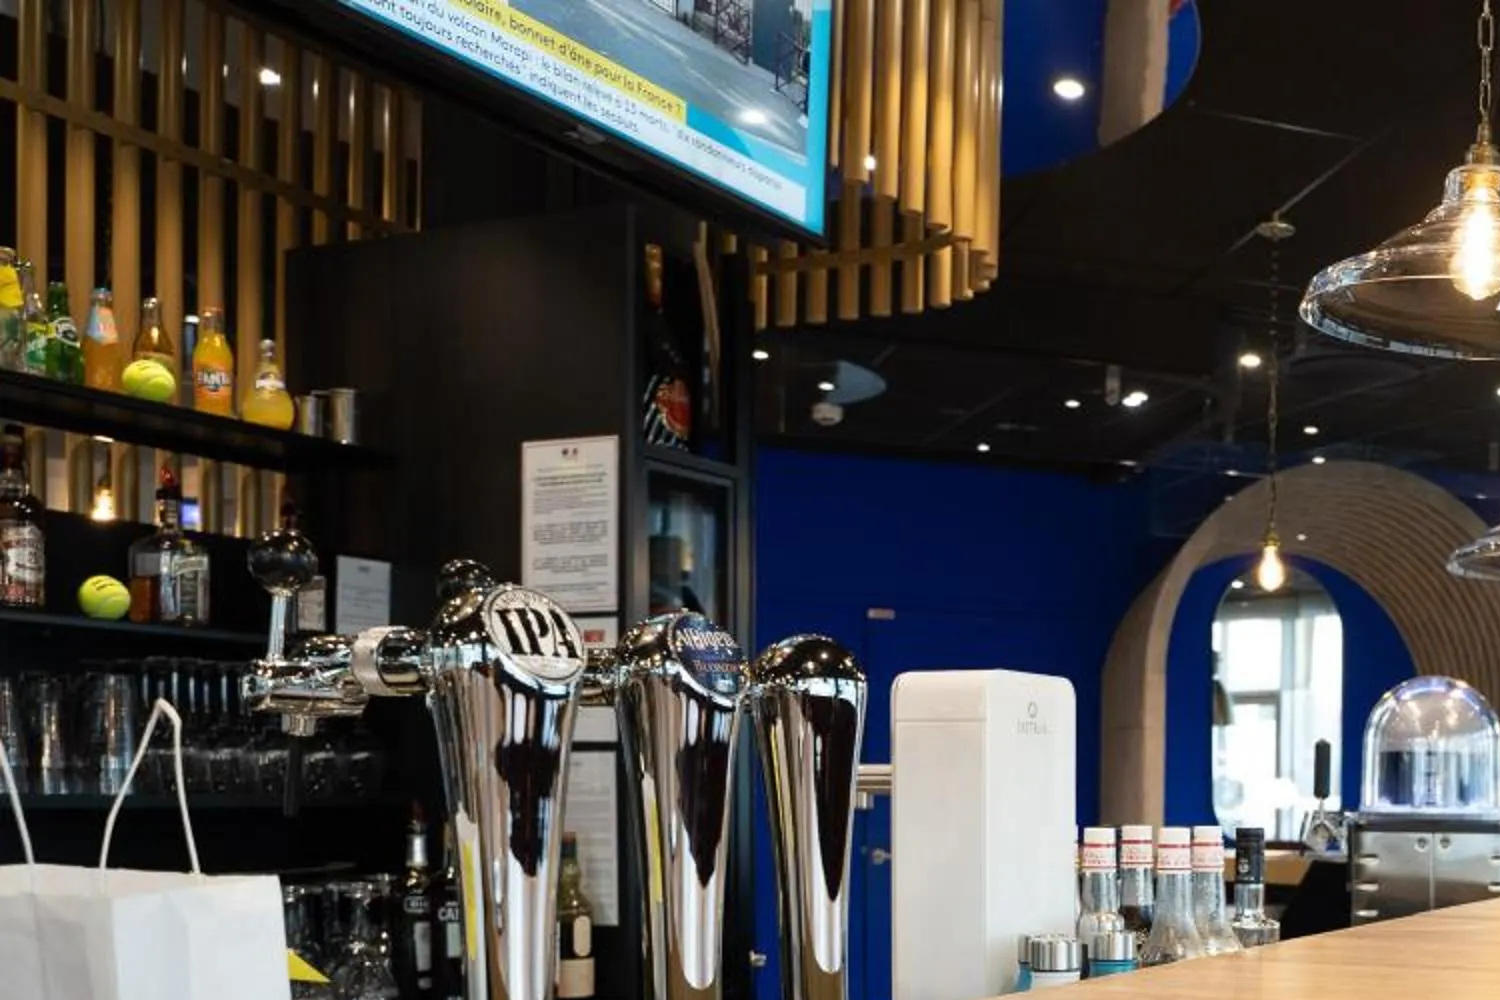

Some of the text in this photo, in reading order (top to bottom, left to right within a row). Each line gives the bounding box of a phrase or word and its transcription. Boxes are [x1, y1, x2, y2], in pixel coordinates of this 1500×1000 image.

[399, 4, 453, 41] toujours
[447, 11, 486, 38] volcan
[508, 14, 556, 51] bonnet
[593, 62, 621, 82] pour
[494, 606, 581, 659] IPA
